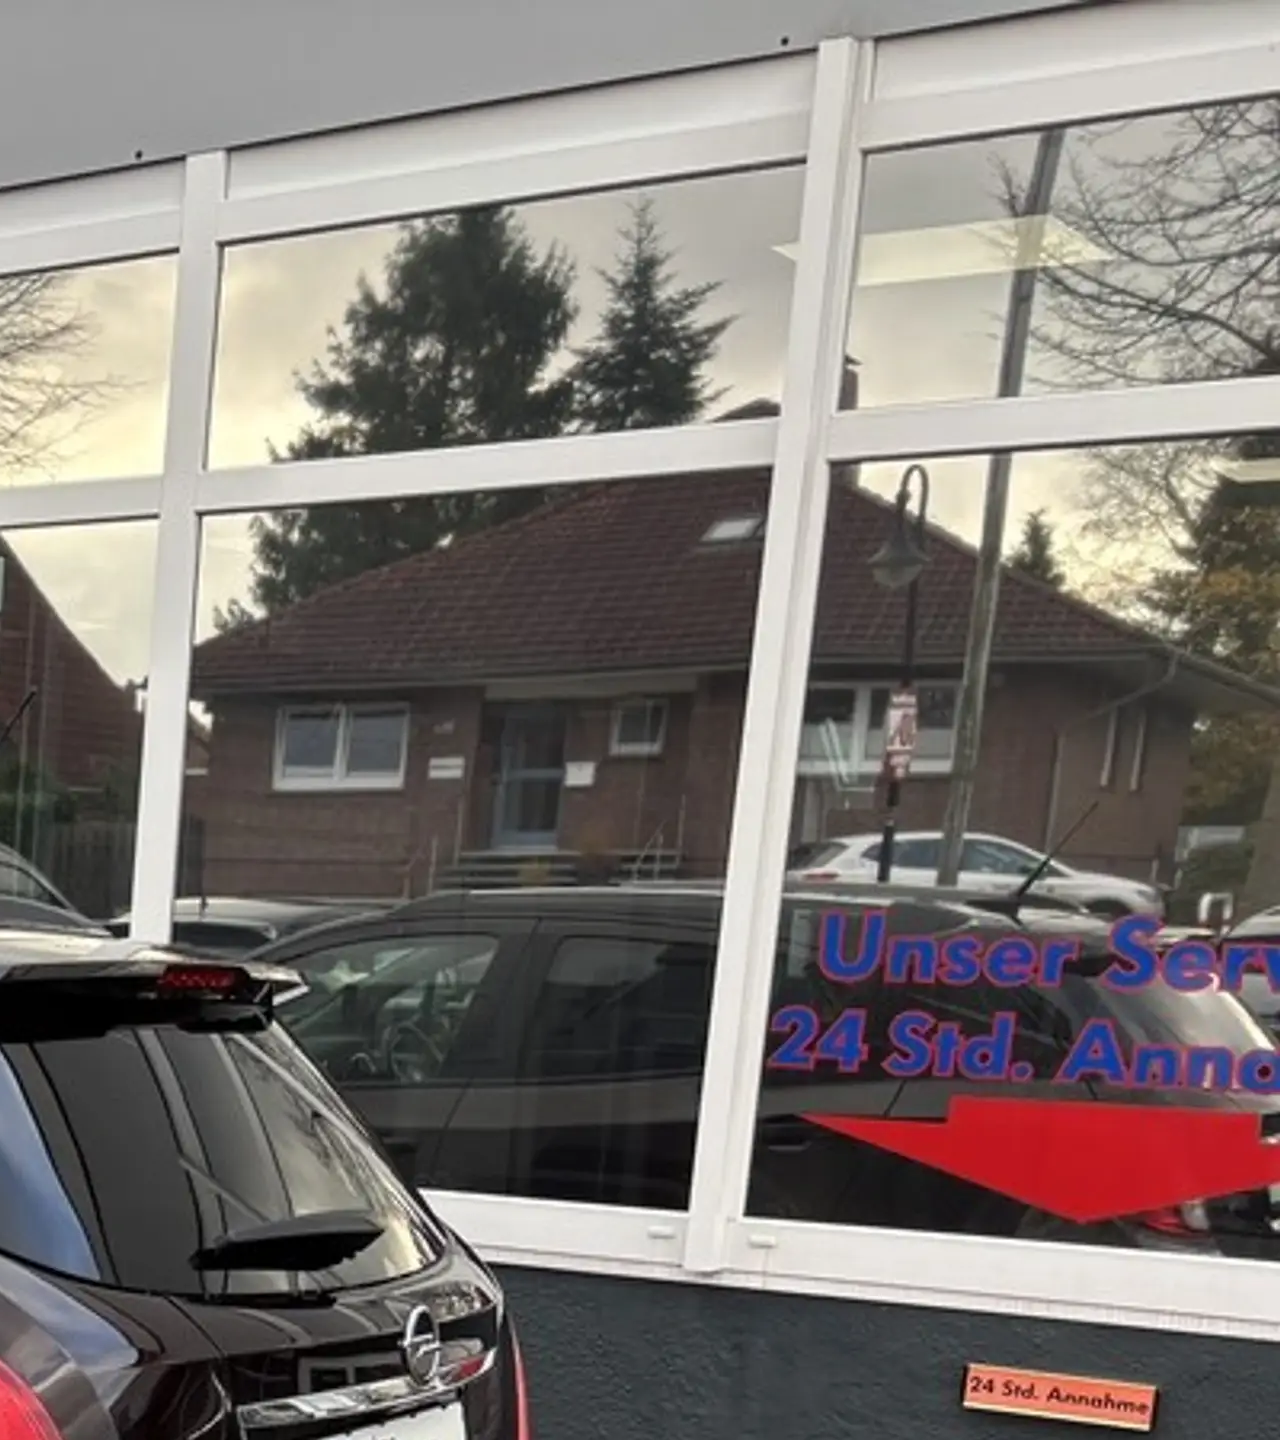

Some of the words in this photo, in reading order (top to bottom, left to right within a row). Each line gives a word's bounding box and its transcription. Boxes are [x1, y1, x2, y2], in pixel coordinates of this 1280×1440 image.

[818, 909, 1081, 988] Unser
[768, 1006, 868, 1071] 24
[881, 1009, 1034, 1081] Std.
[969, 1375, 995, 1394] 24
[1002, 1379, 1039, 1400] Std.
[1046, 1386, 1150, 1416] Annahme
